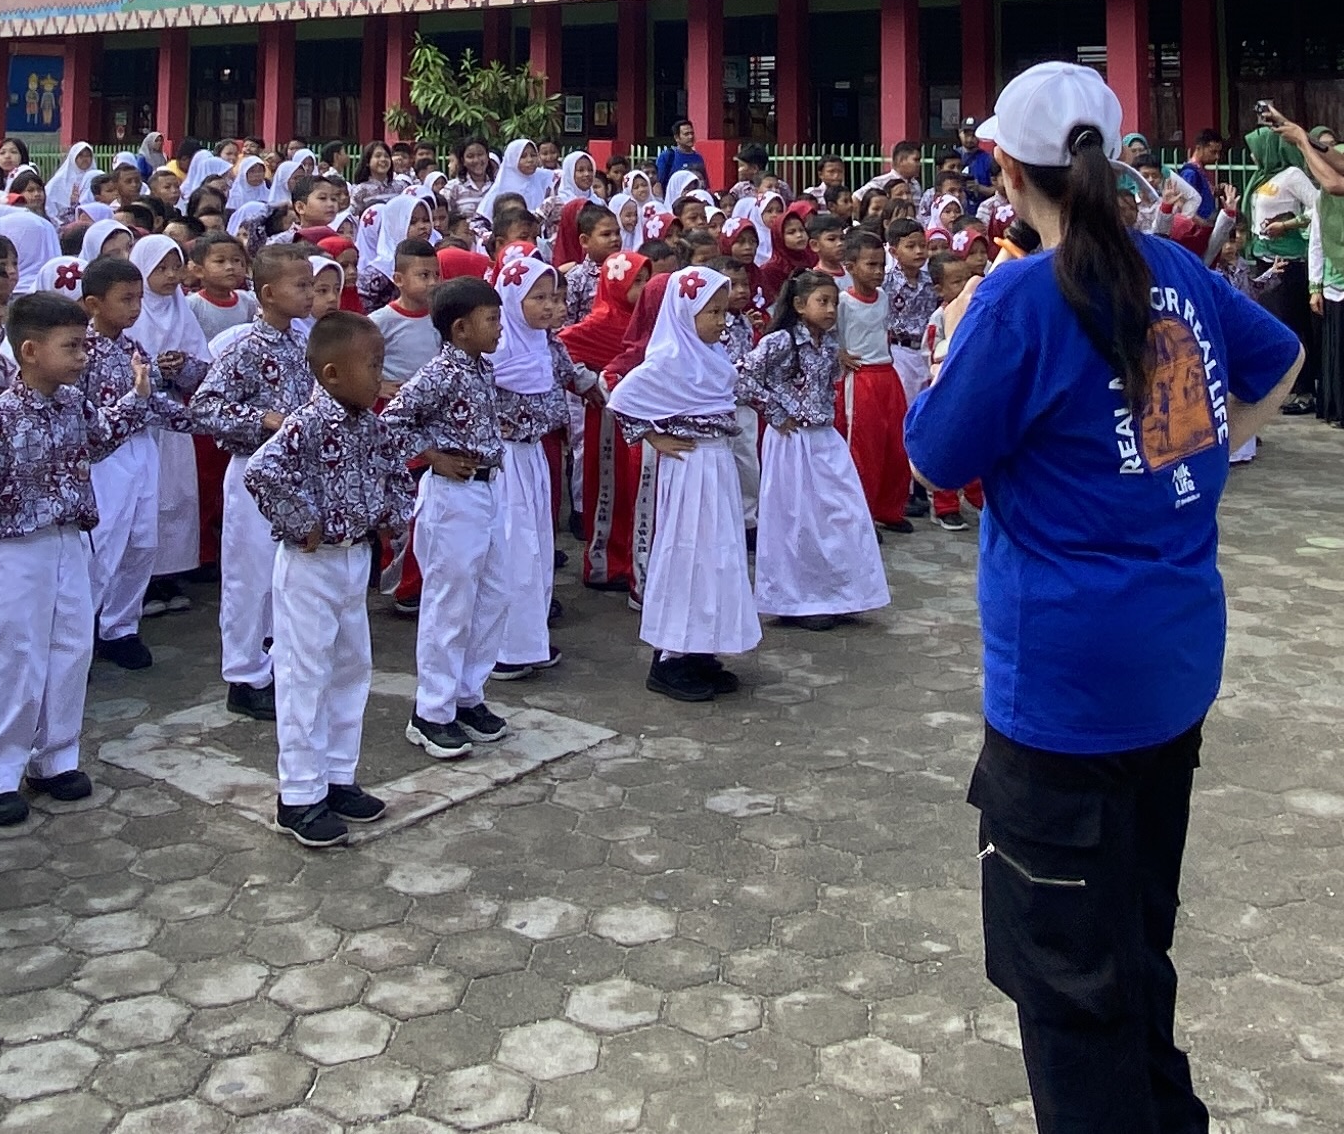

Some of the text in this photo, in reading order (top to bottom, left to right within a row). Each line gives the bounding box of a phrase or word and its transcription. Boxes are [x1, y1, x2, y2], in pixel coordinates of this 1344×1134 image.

[1149, 286, 1229, 445] OR REAL LIFE
[1114, 407, 1145, 475] REAL
[1175, 477, 1196, 496] Life
